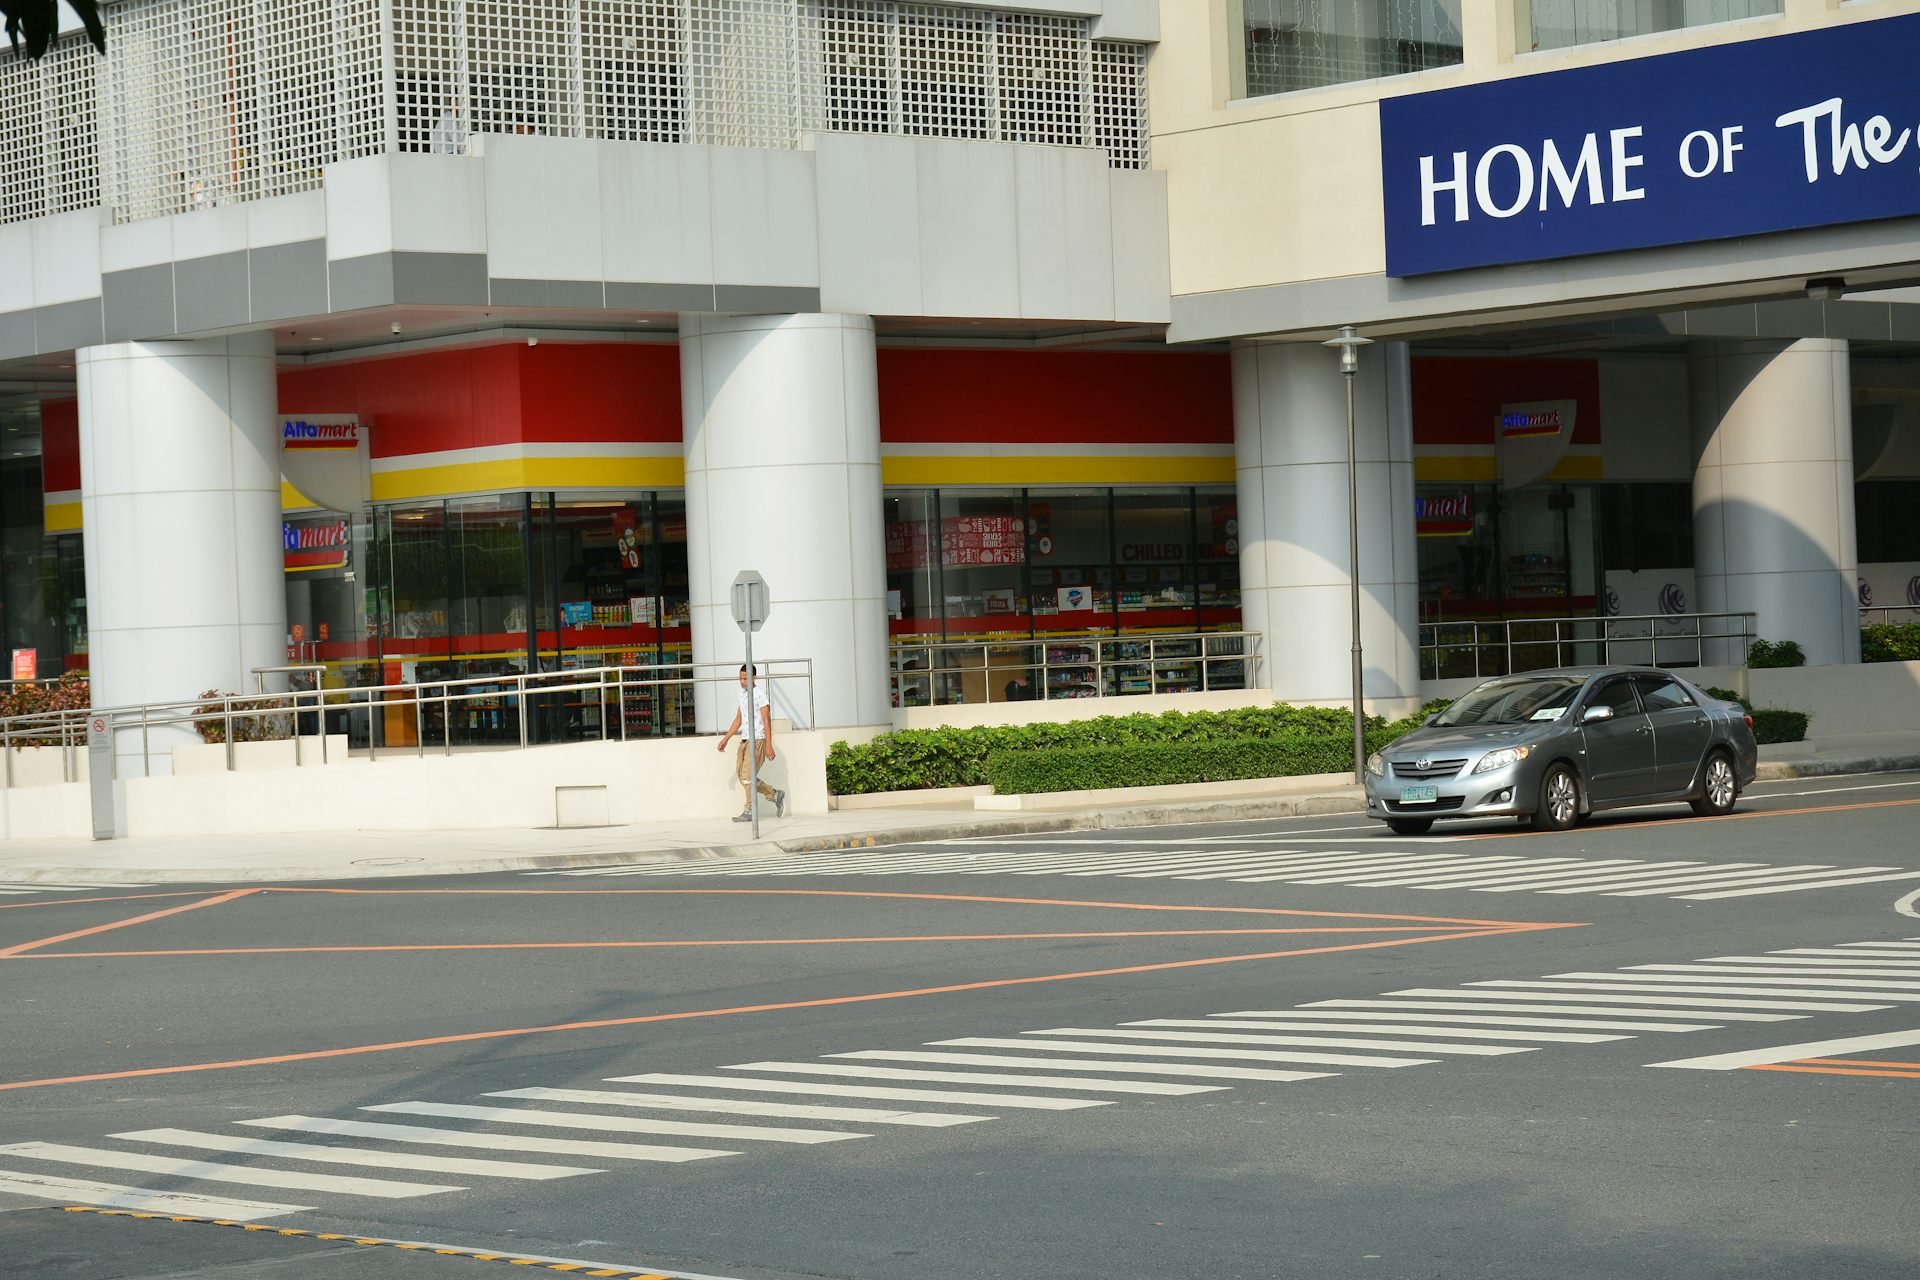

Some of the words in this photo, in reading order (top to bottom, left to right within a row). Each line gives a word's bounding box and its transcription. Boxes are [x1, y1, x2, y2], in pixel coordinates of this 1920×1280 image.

[1419, 125, 1646, 227] HOME
[1678, 125, 1744, 179] OF
[1775, 97, 1912, 184] The
[1503, 410, 1560, 429] Alfamart
[283, 420, 358, 438] Alfamart
[1121, 543, 1183, 561] CHILLED
